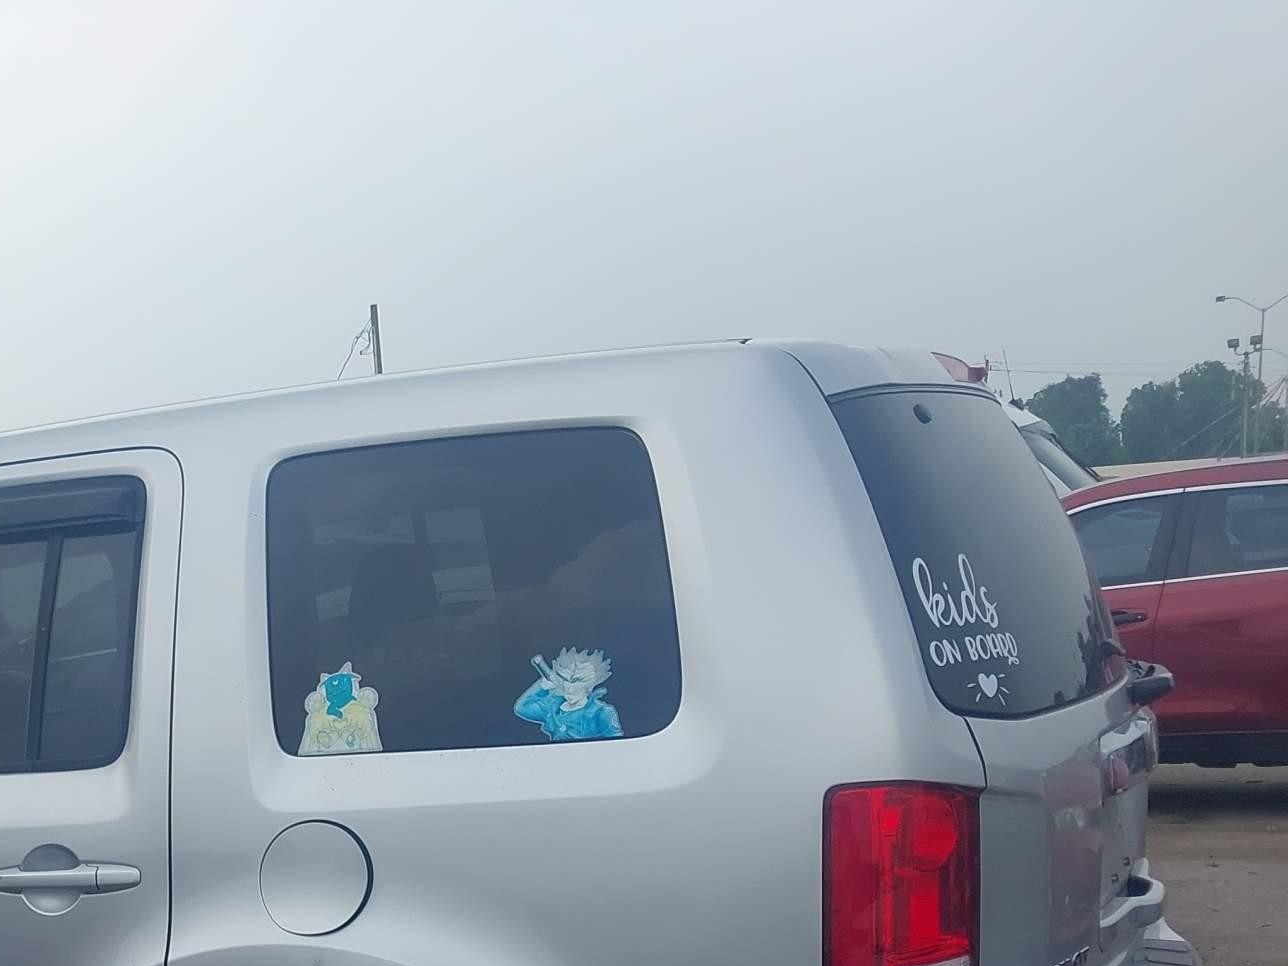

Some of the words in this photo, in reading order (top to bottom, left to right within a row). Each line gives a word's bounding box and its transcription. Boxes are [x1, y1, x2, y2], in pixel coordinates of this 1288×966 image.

[912, 553, 999, 629] kids
[929, 639, 963, 667] ON
[964, 632, 1020, 665] BOARD
